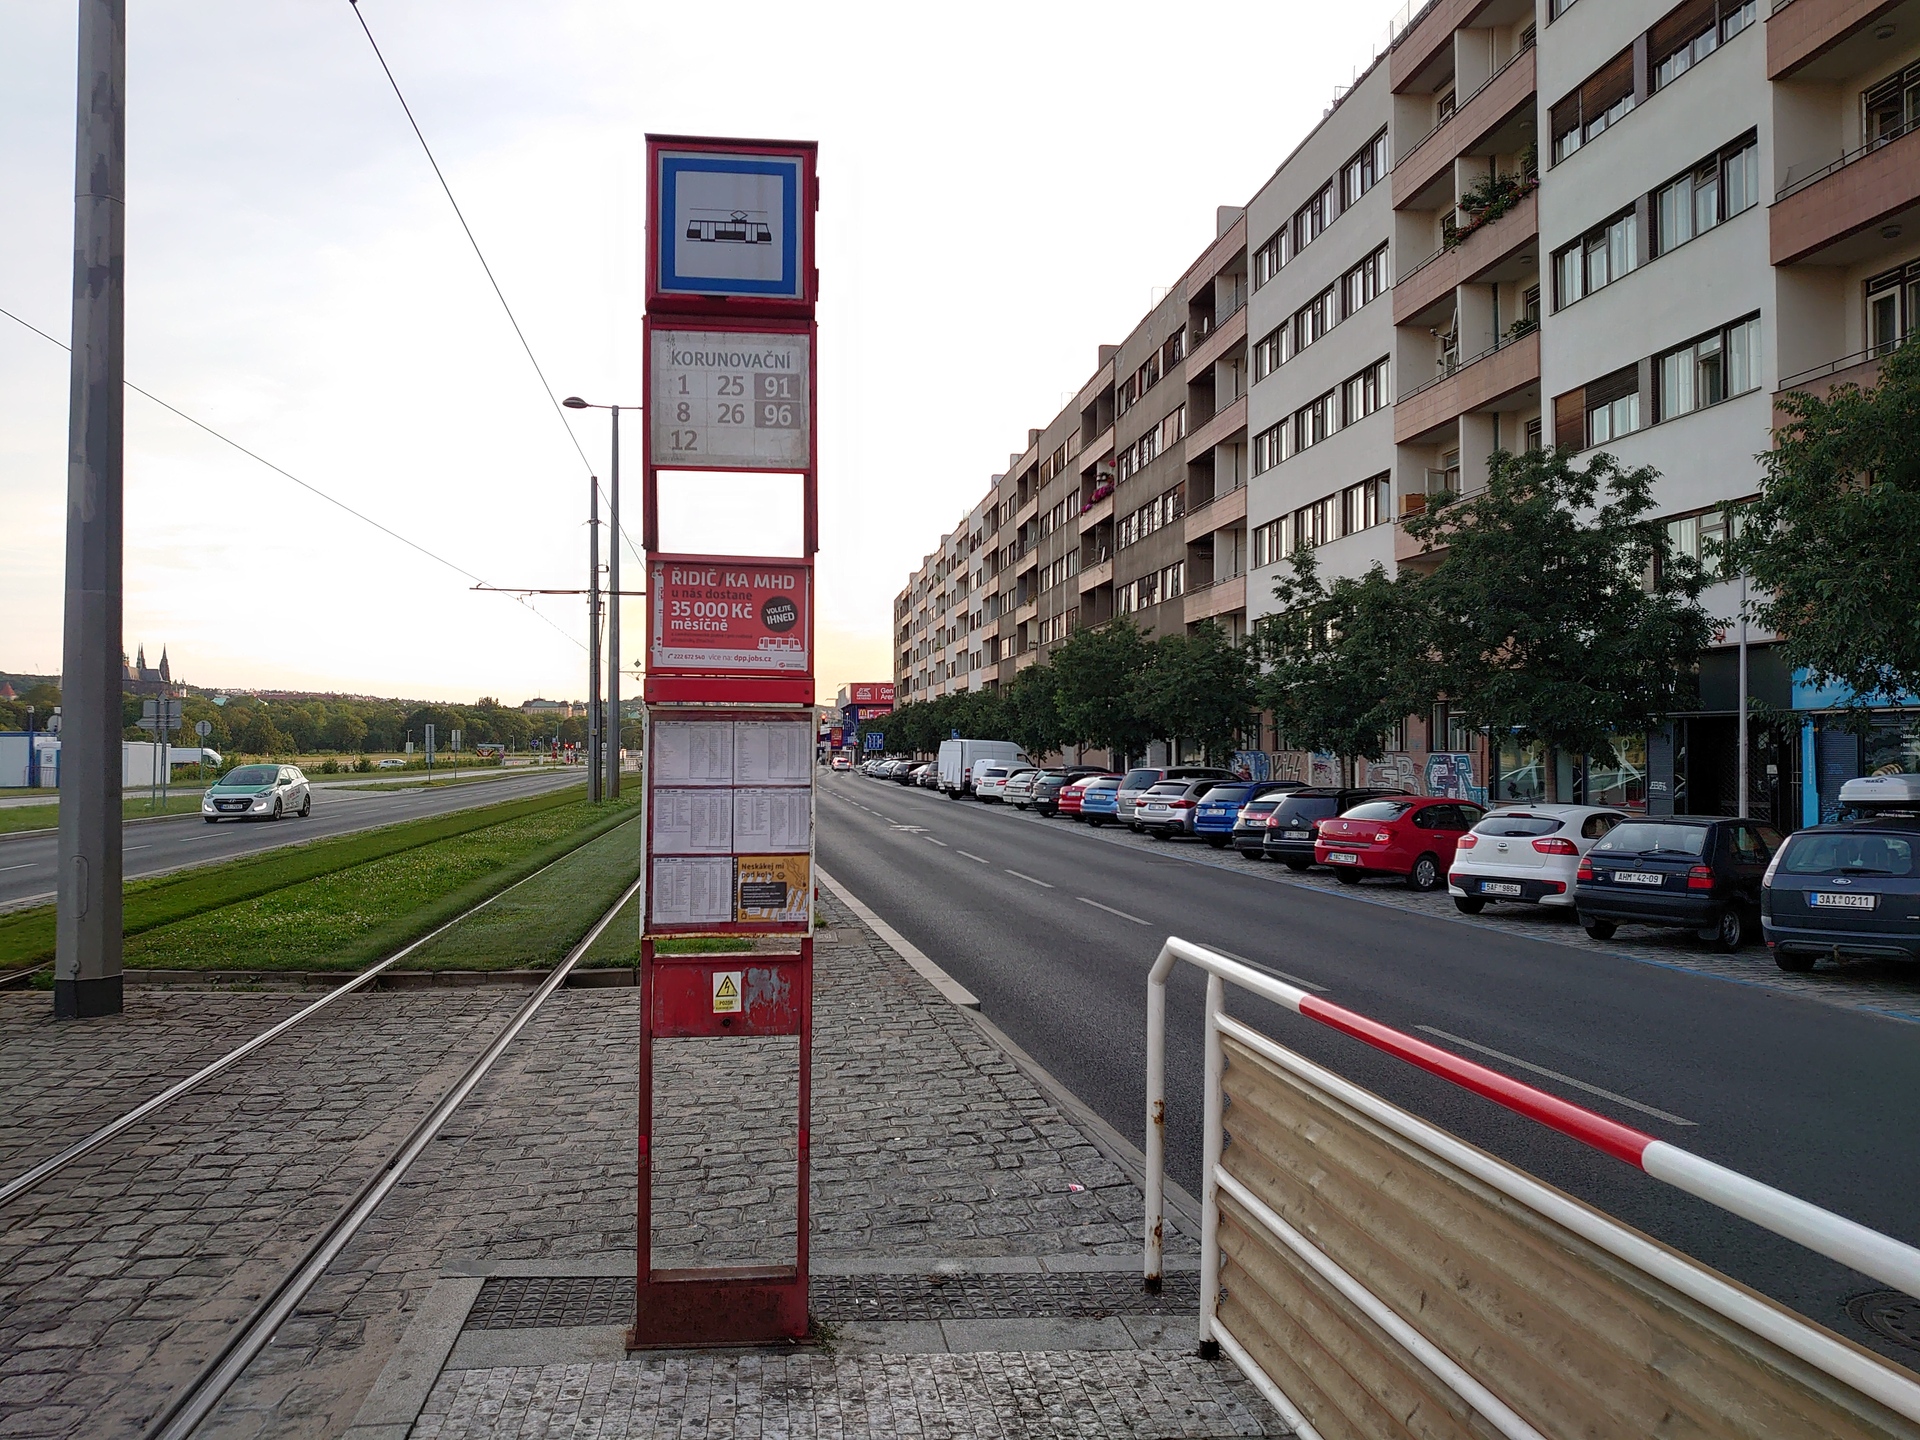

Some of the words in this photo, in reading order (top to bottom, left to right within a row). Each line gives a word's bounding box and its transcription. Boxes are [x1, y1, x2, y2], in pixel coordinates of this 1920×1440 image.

[671, 350, 791, 369] KORUNOVAČNÍ
[678, 374, 690, 395] 1
[717, 375, 745, 396] 25
[764, 376, 791, 398] 91
[676, 402, 691, 423] 8
[717, 403, 745, 424] 26
[764, 404, 792, 426] 96
[671, 430, 698, 451] 12
[753, 573, 796, 590] MHD
[671, 590, 679, 598] u
[682, 588, 702, 599] nás
[705, 588, 753, 600] dostane
[670, 601, 691, 617] 35
[693, 602, 729, 619] 000
[731, 603, 753, 620] Kč
[766, 604, 792, 615] VOLEJTE
[670, 617, 729, 632] měsíčně
[766, 612, 796, 625] IHNED
[708, 653, 722, 661] více
[733, 654, 772, 663] dpp.jobs.cz
[1618, 873, 1633, 881] AHM
[1637, 874, 1659, 884] 42-09
[1819, 894, 1837, 904] 3AX
[1844, 896, 1869, 906] 0211
